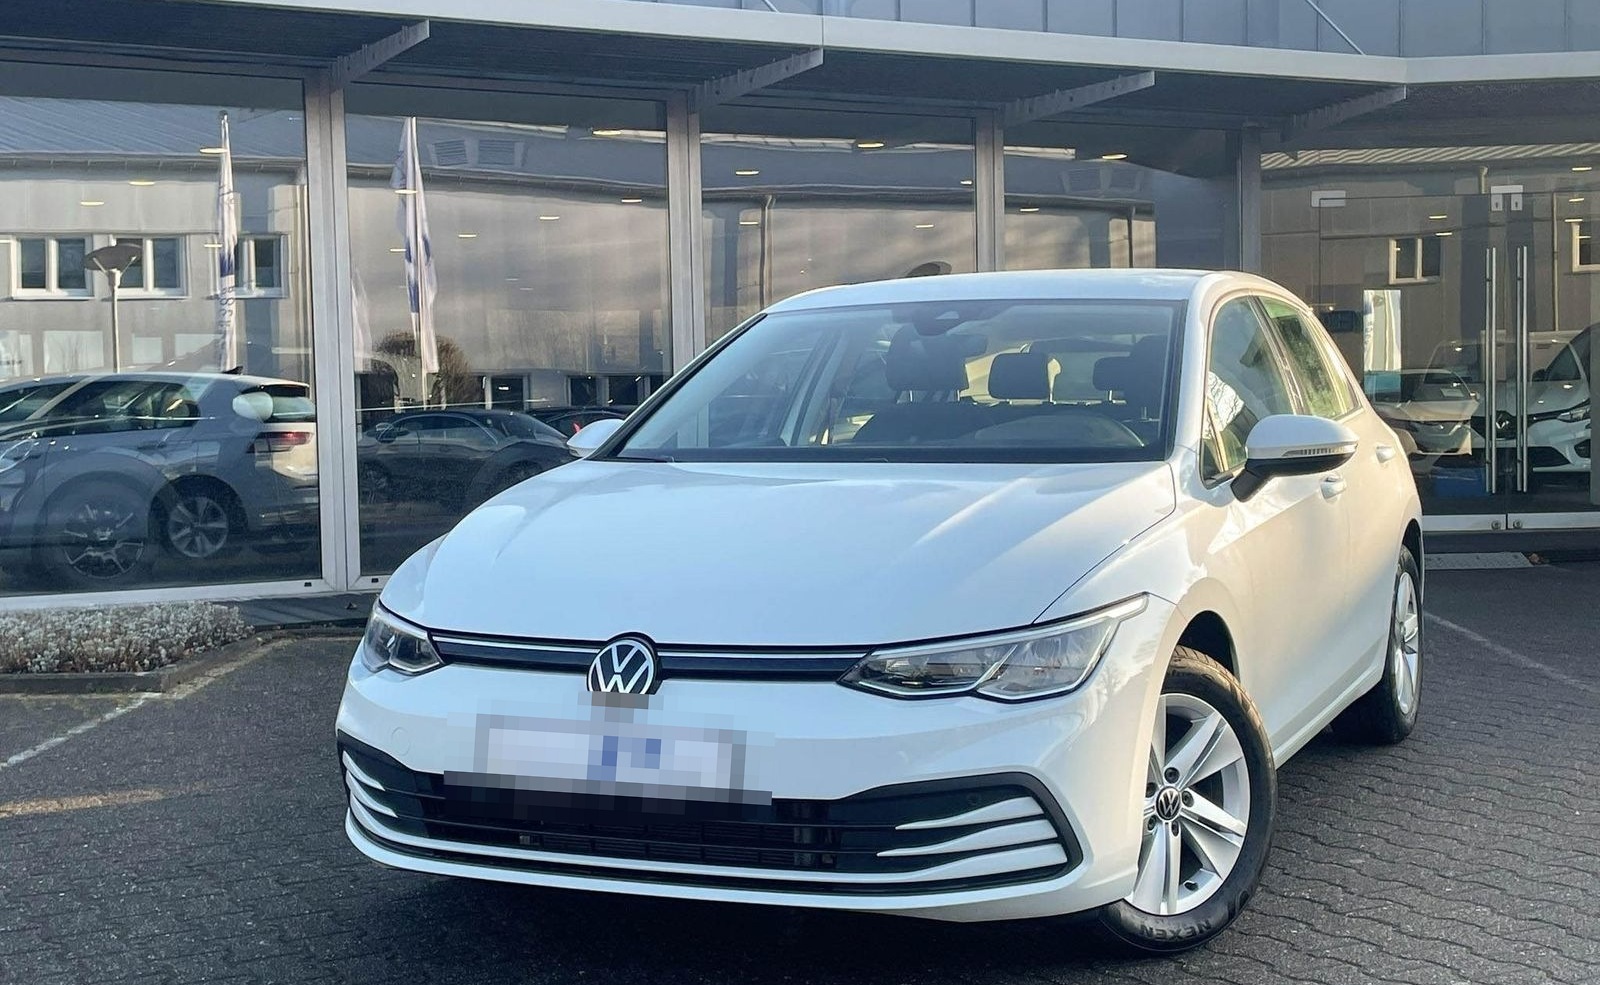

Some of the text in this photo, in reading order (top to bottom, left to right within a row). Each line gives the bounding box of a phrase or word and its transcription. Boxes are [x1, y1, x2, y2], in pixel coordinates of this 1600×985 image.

[589, 640, 654, 694] VW
[1159, 788, 1180, 819] VW
[1140, 919, 1212, 942] NEXEN
